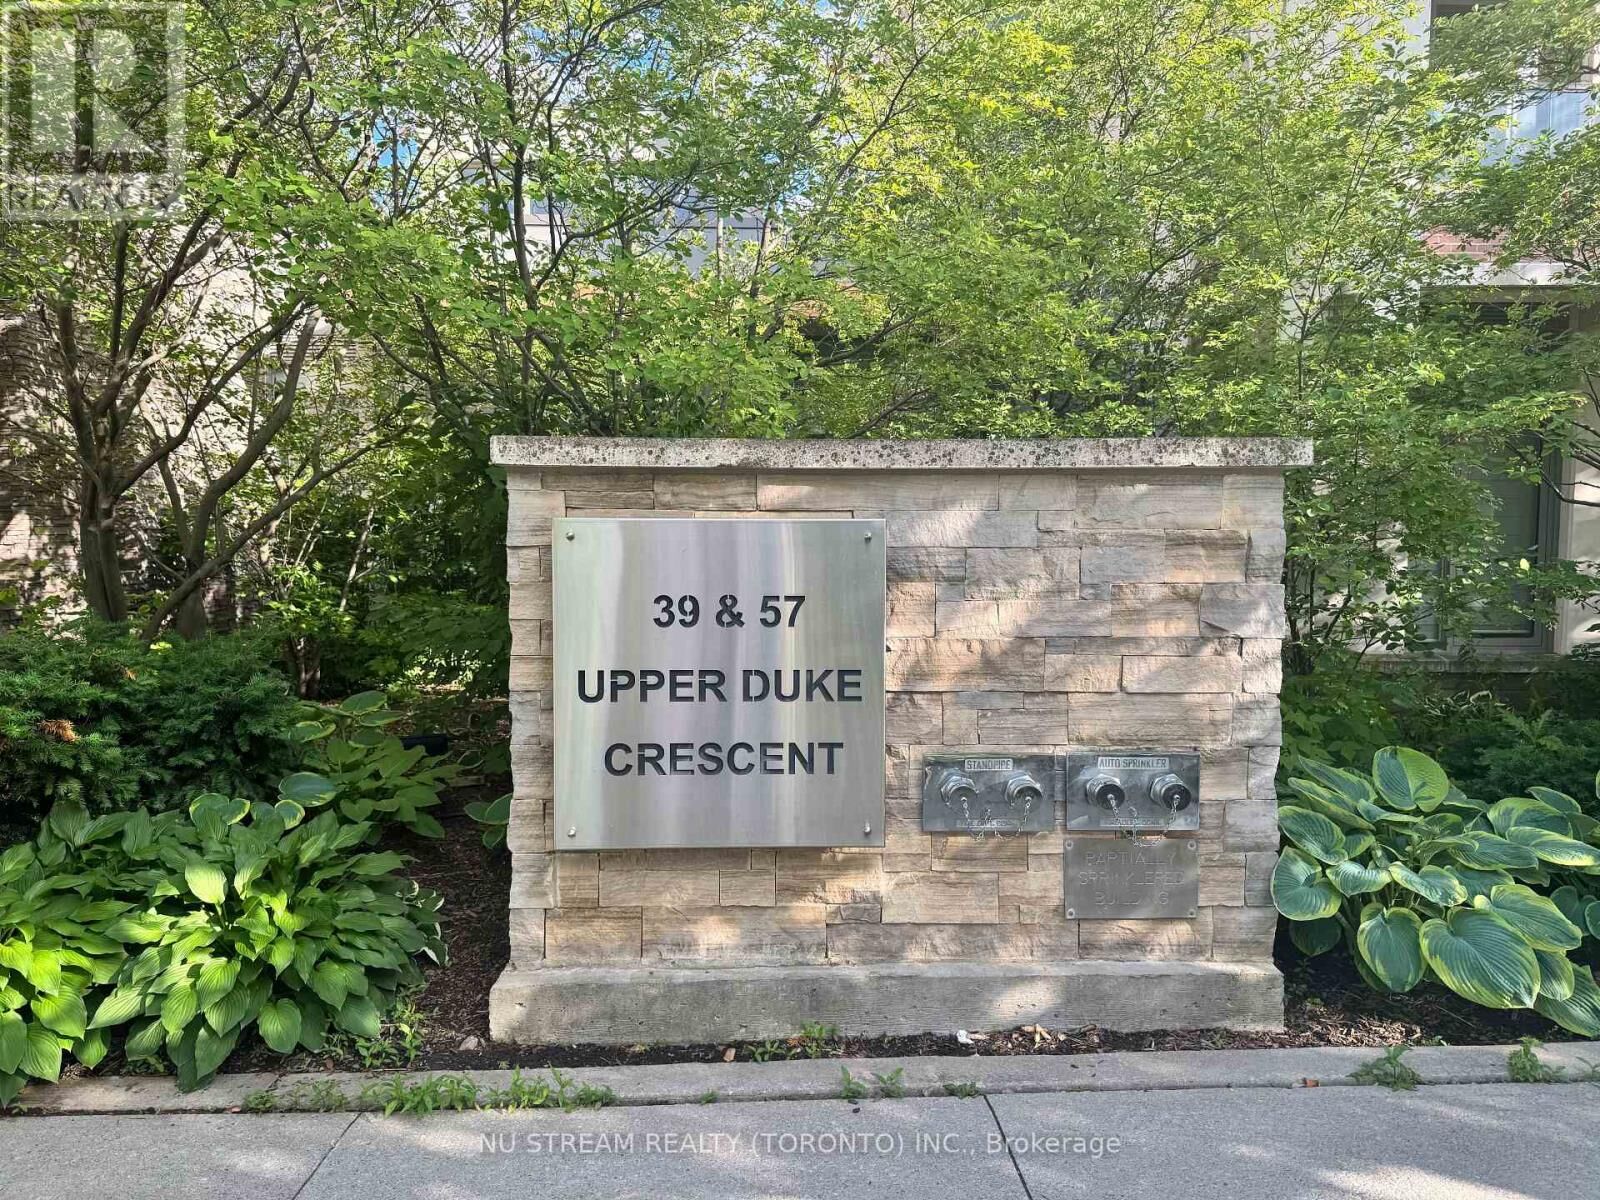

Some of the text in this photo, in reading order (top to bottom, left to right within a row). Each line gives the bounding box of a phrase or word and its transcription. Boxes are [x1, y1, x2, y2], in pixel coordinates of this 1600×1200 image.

[653, 594, 806, 627] 39 & 57
[577, 669, 862, 702] UPPER DUKE
[604, 742, 844, 776] CRESCENT
[966, 760, 1012, 770] STANDPIPE
[1099, 758, 1167, 768] AUTO SPRINKLER
[1095, 891, 1169, 905] BUILDNG
